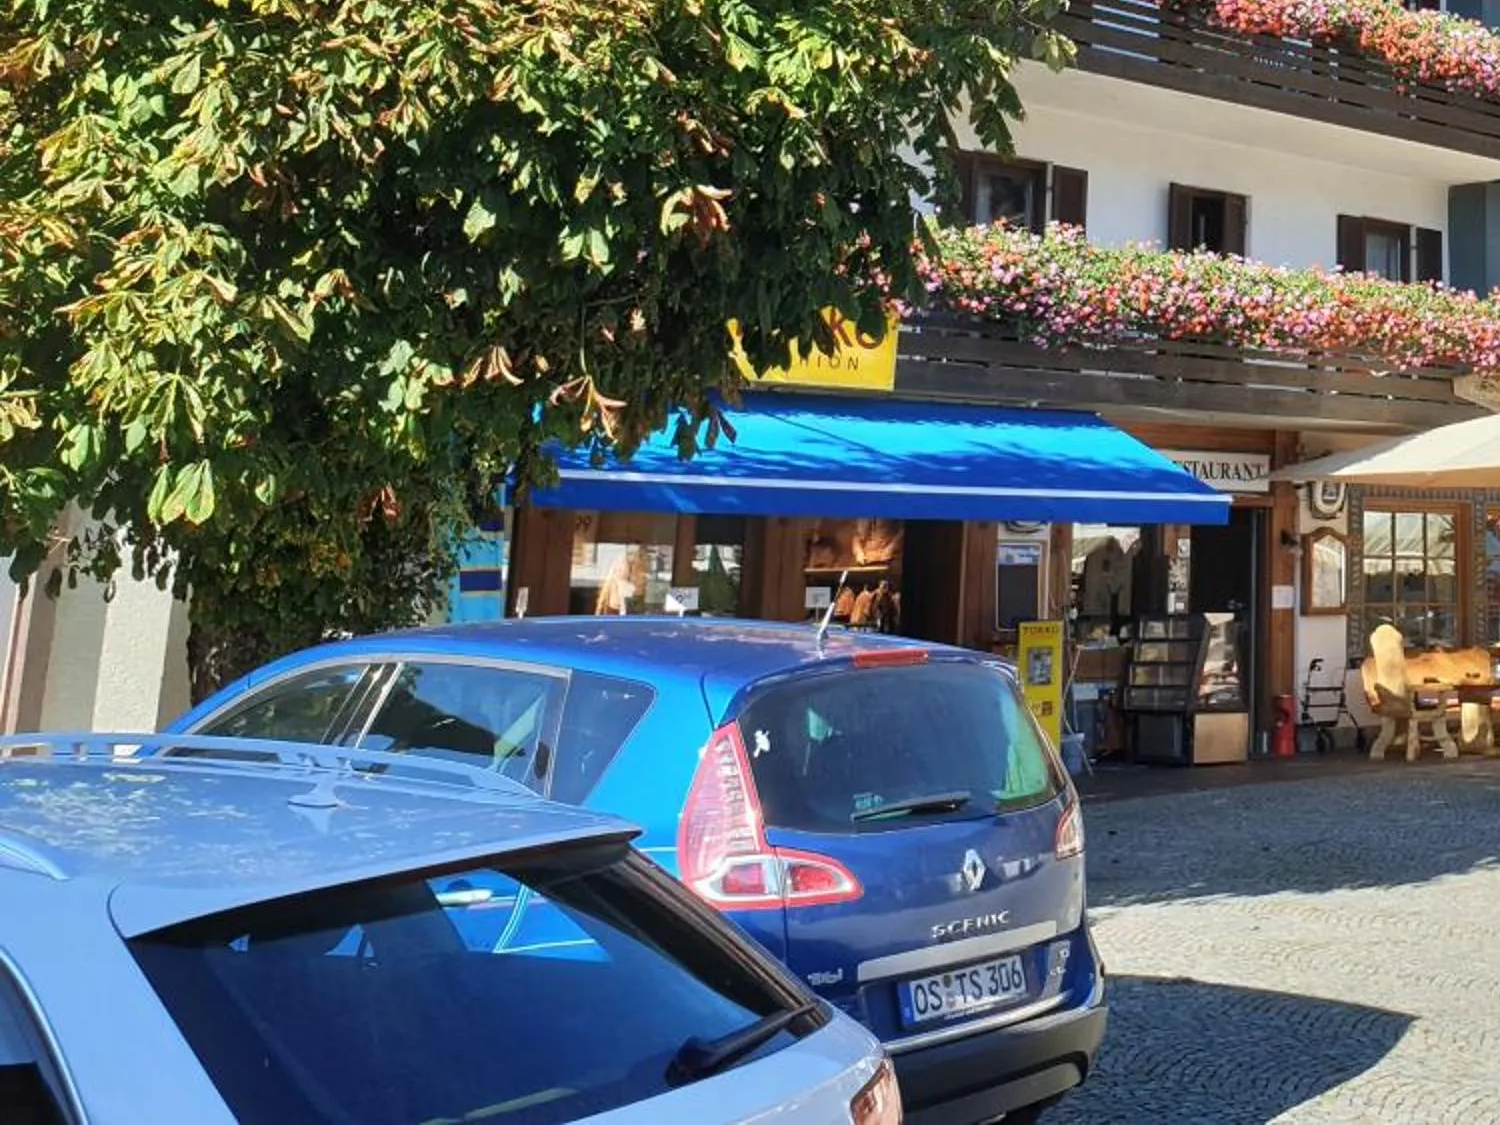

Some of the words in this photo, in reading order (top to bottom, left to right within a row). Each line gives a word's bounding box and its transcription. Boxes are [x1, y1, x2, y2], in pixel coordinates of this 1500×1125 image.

[1174, 459, 1266, 481] STAURANT
[913, 980, 943, 1015] OS
[955, 969, 983, 1003] TS
[986, 961, 1023, 996] 306
